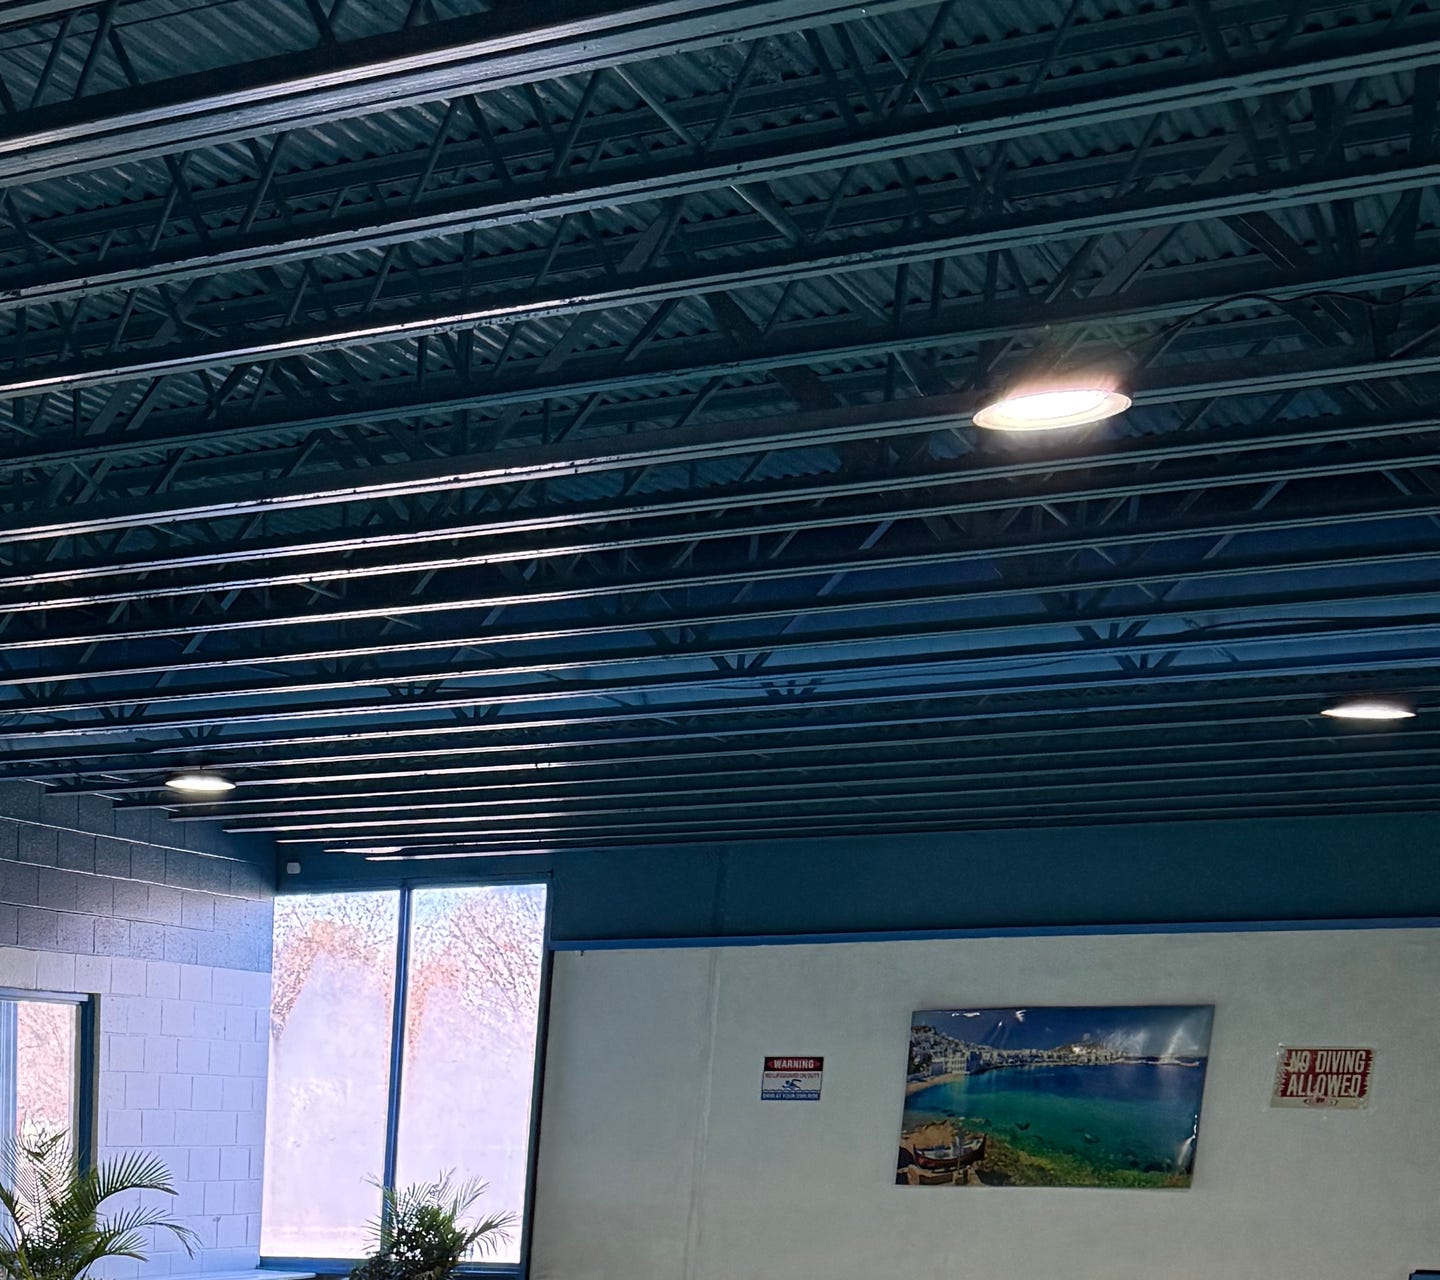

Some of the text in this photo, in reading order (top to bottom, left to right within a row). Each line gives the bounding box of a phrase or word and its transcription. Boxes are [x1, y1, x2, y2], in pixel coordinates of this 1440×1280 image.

[773, 1059, 814, 1069] WARNING
[1287, 1050, 1366, 1073] NO DIVING
[1286, 1074, 1362, 1097] ALLOWED
